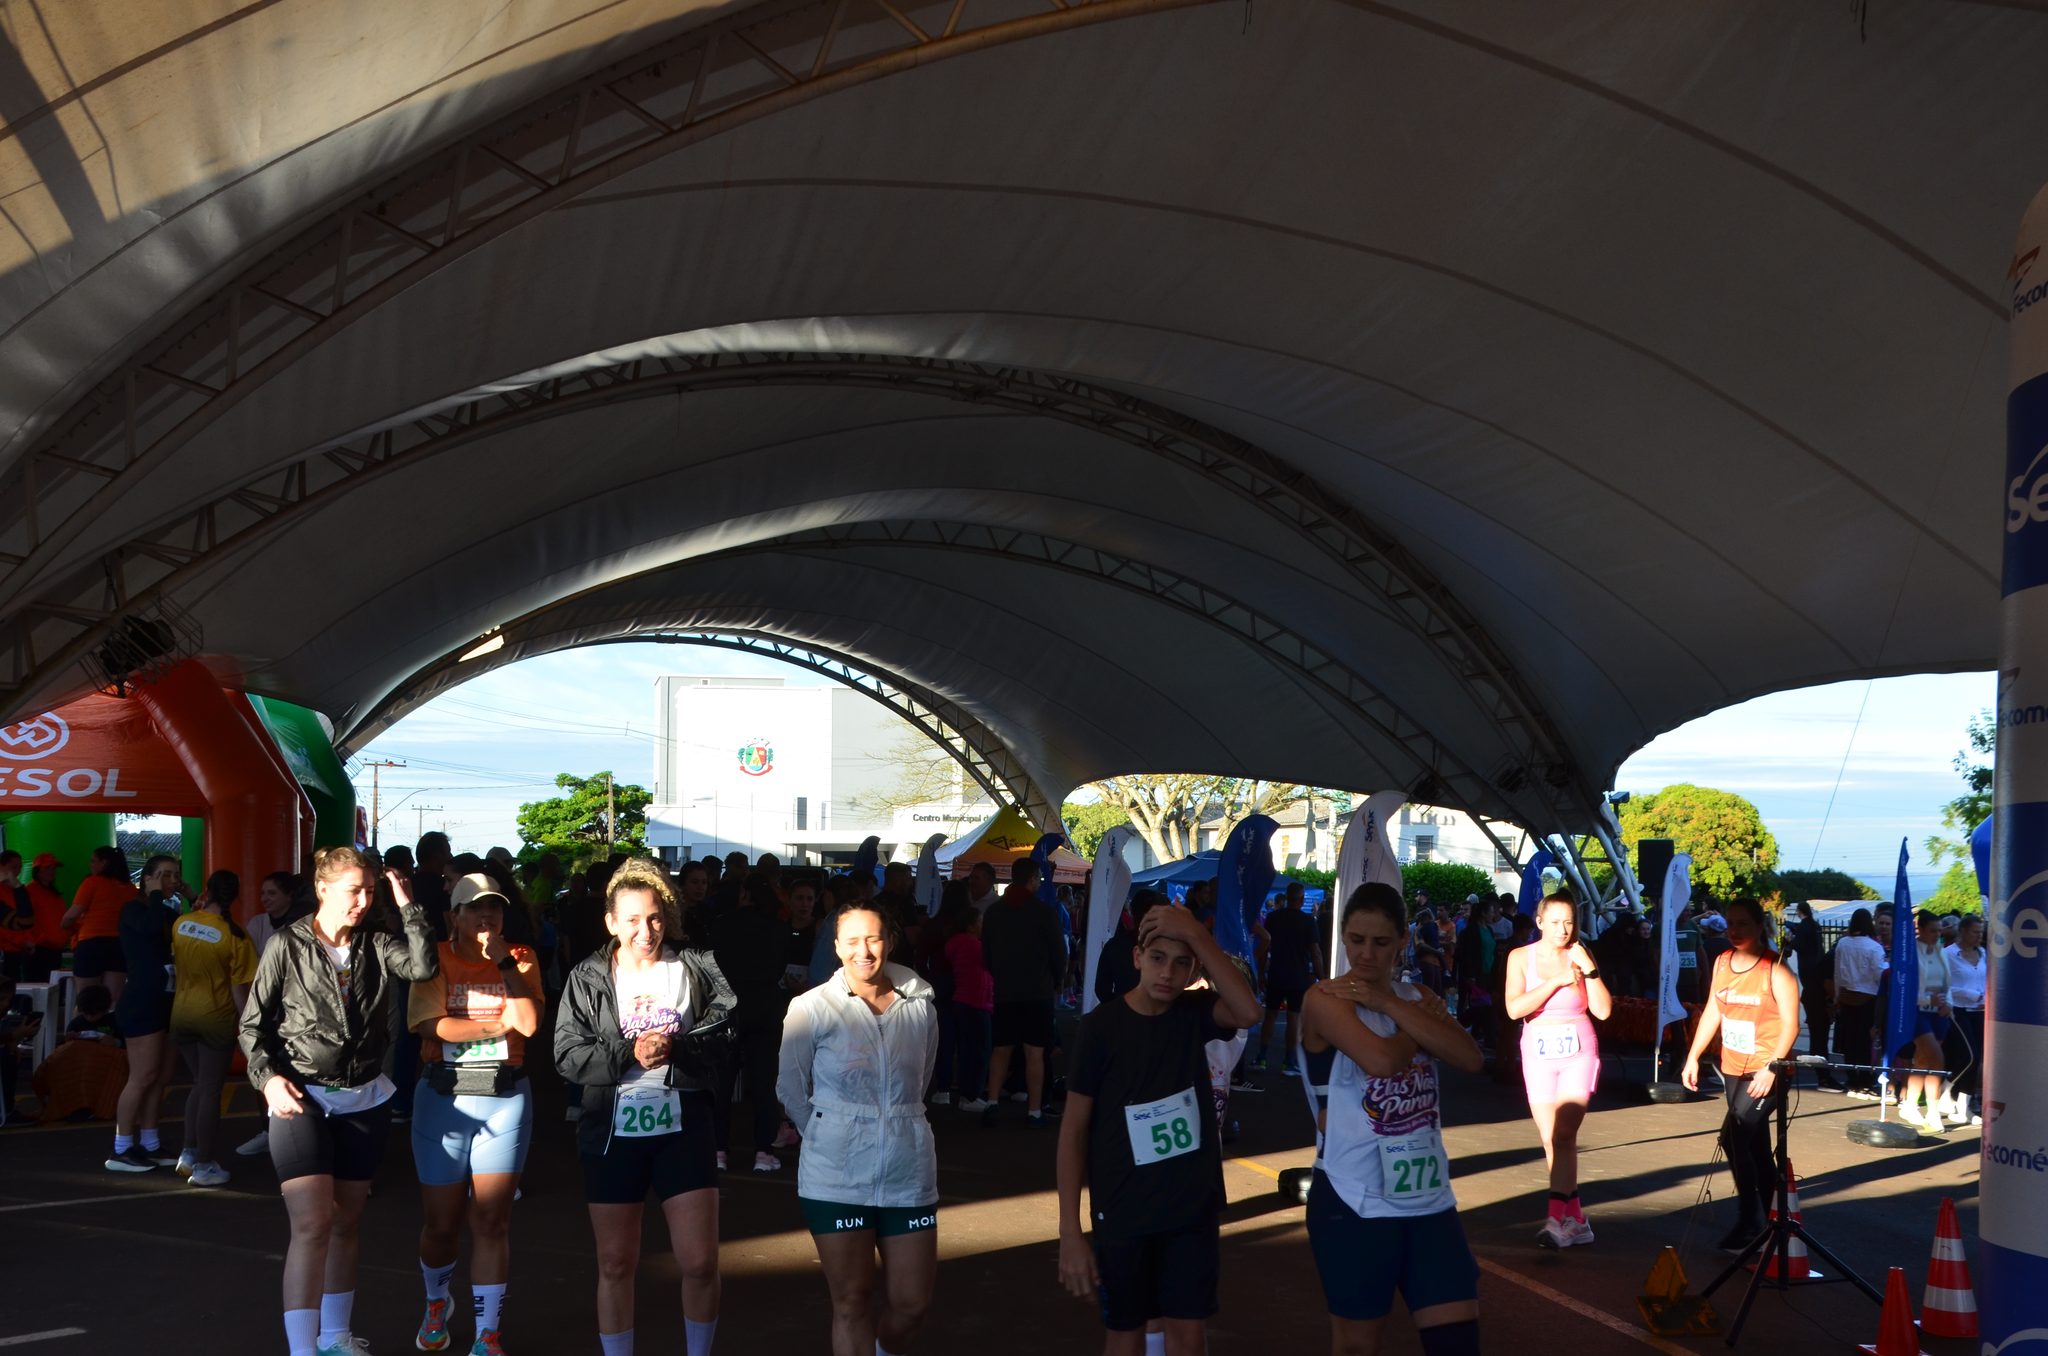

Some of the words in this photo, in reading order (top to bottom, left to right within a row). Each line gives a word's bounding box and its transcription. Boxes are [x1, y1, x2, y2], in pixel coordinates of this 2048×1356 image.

[912, 813, 941, 822] Centro
[942, 813, 982, 824] Municipal
[621, 1102, 673, 1133] 264
[1151, 1117, 1192, 1155] 58
[1393, 1154, 1441, 1193] 272
[836, 1216, 863, 1230] RUN
